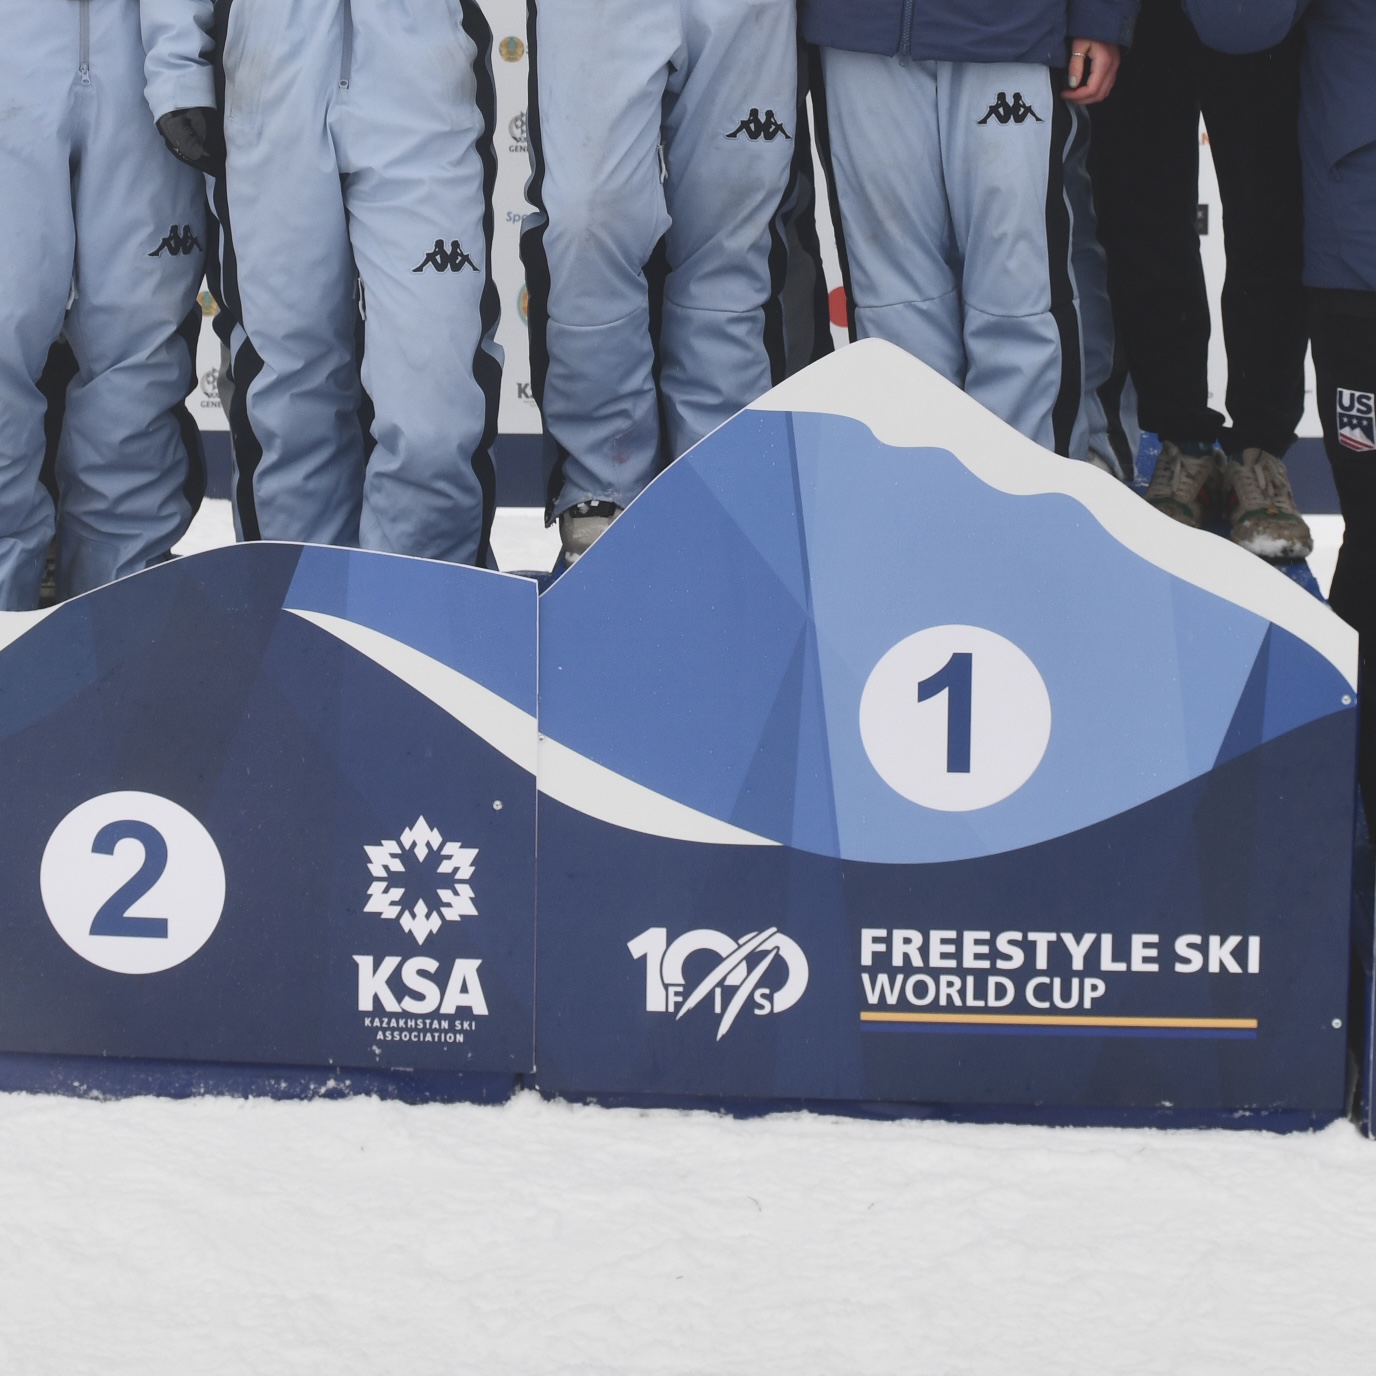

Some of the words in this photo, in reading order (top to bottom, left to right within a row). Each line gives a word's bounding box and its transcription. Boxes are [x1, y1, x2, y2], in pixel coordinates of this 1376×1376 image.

[1338, 390, 1373, 415] US
[917, 652, 973, 773] 1
[88, 819, 168, 939] 2
[860, 928, 1159, 972] FREESTYLE
[1174, 934, 1260, 974] SKI
[352, 955, 489, 1015] KSA
[861, 973, 1016, 1008] WORLD
[1024, 976, 1106, 1010] CUP
[364, 1017, 449, 1030] KAZAKHSTAN
[455, 1020, 476, 1030] SKI
[376, 1031, 464, 1043] ASSOCIATION
